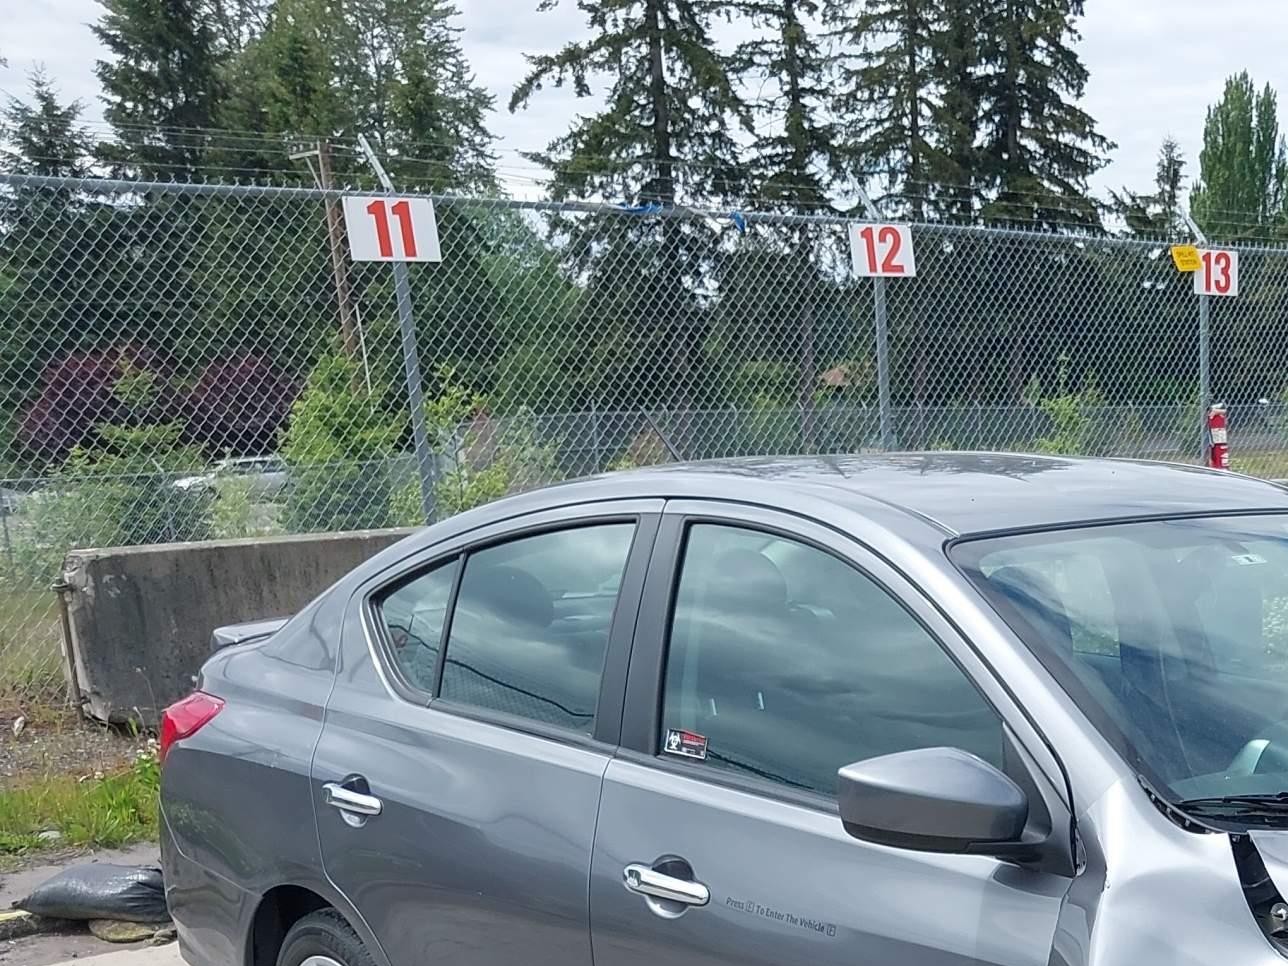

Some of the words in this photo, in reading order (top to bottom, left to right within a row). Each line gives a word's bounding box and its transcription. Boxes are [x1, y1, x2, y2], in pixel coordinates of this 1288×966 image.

[366, 200, 418, 258] 11
[860, 226, 905, 274] 12
[1201, 251, 1231, 294] 13
[725, 896, 745, 910] Press
[756, 904, 765, 916] To
[765, 908, 785, 921] Enter
[786, 913, 799, 926] The
[800, 918, 825, 933] Vehicle
